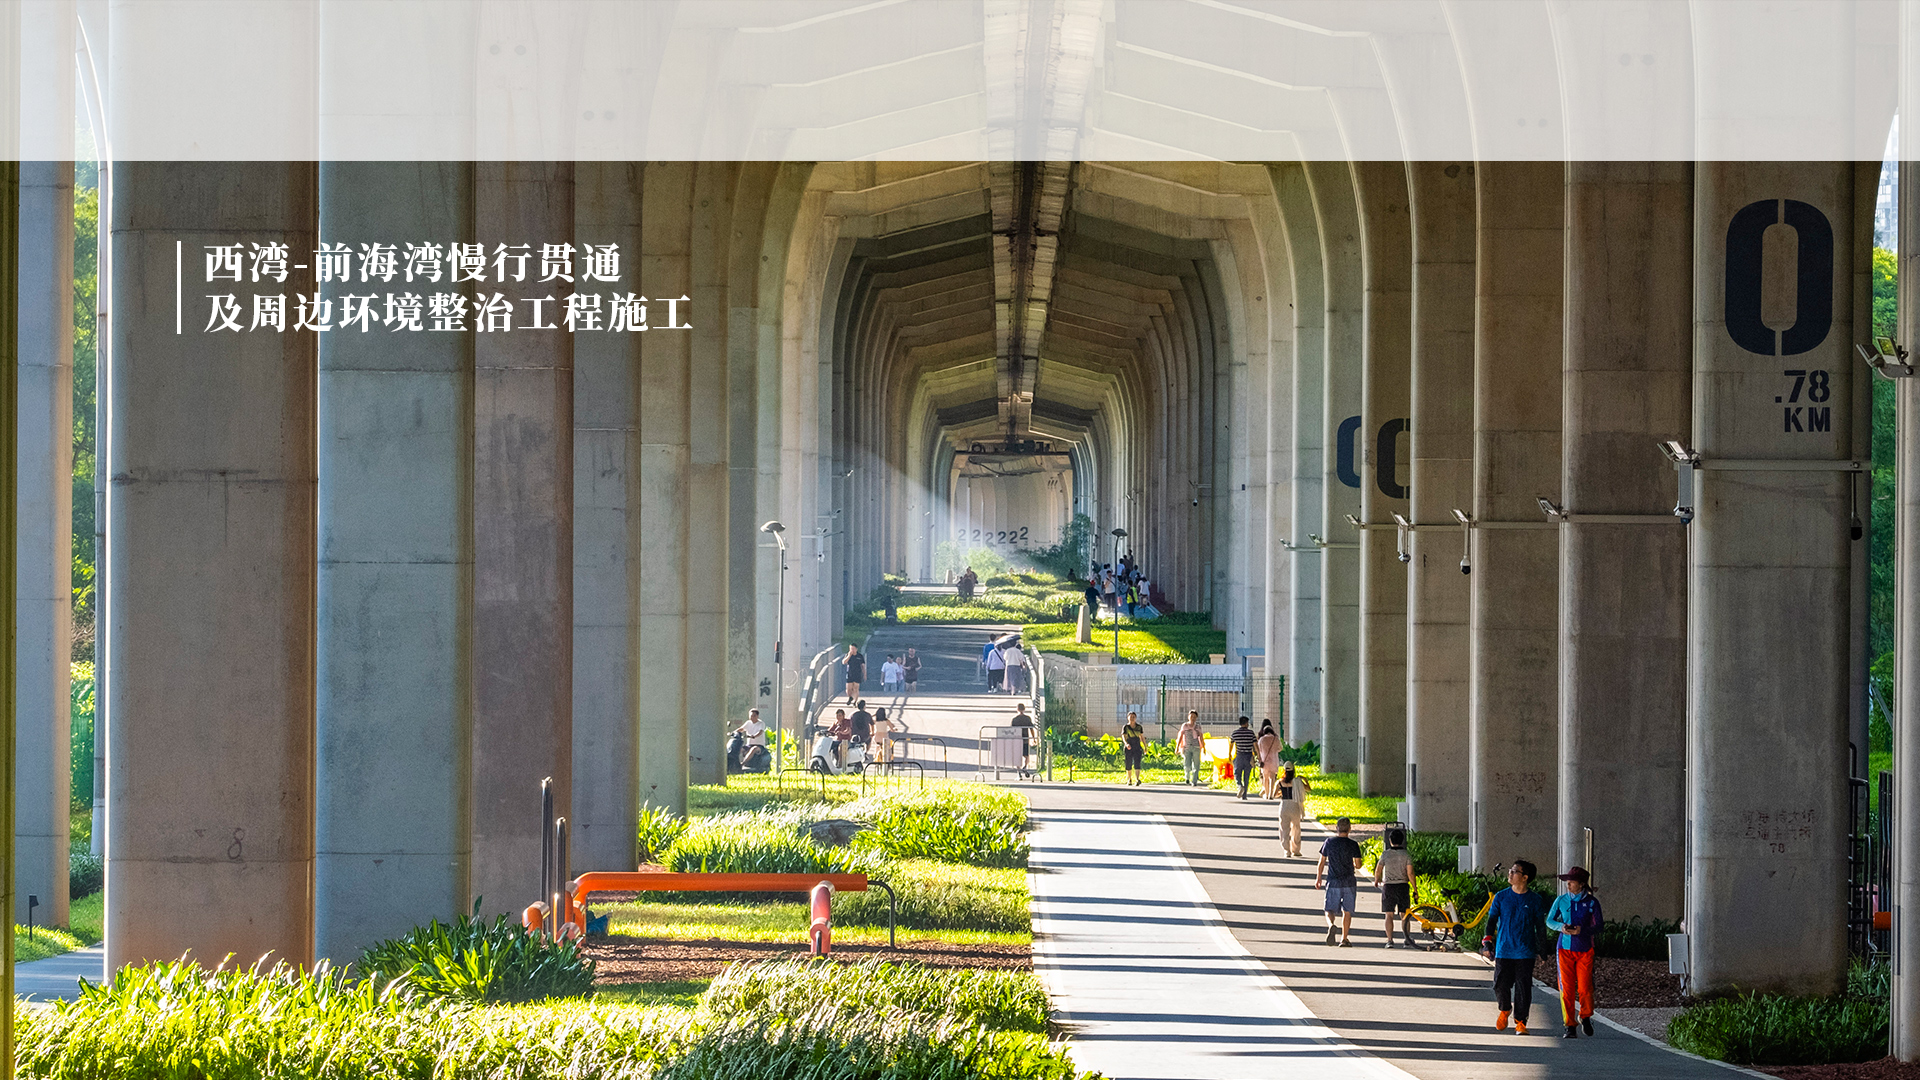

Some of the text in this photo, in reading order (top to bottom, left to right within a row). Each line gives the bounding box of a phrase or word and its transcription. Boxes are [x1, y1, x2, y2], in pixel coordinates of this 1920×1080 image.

[1725, 199, 1834, 356] 0
[1775, 370, 1830, 403] .78
[1784, 407, 1830, 433] KM
